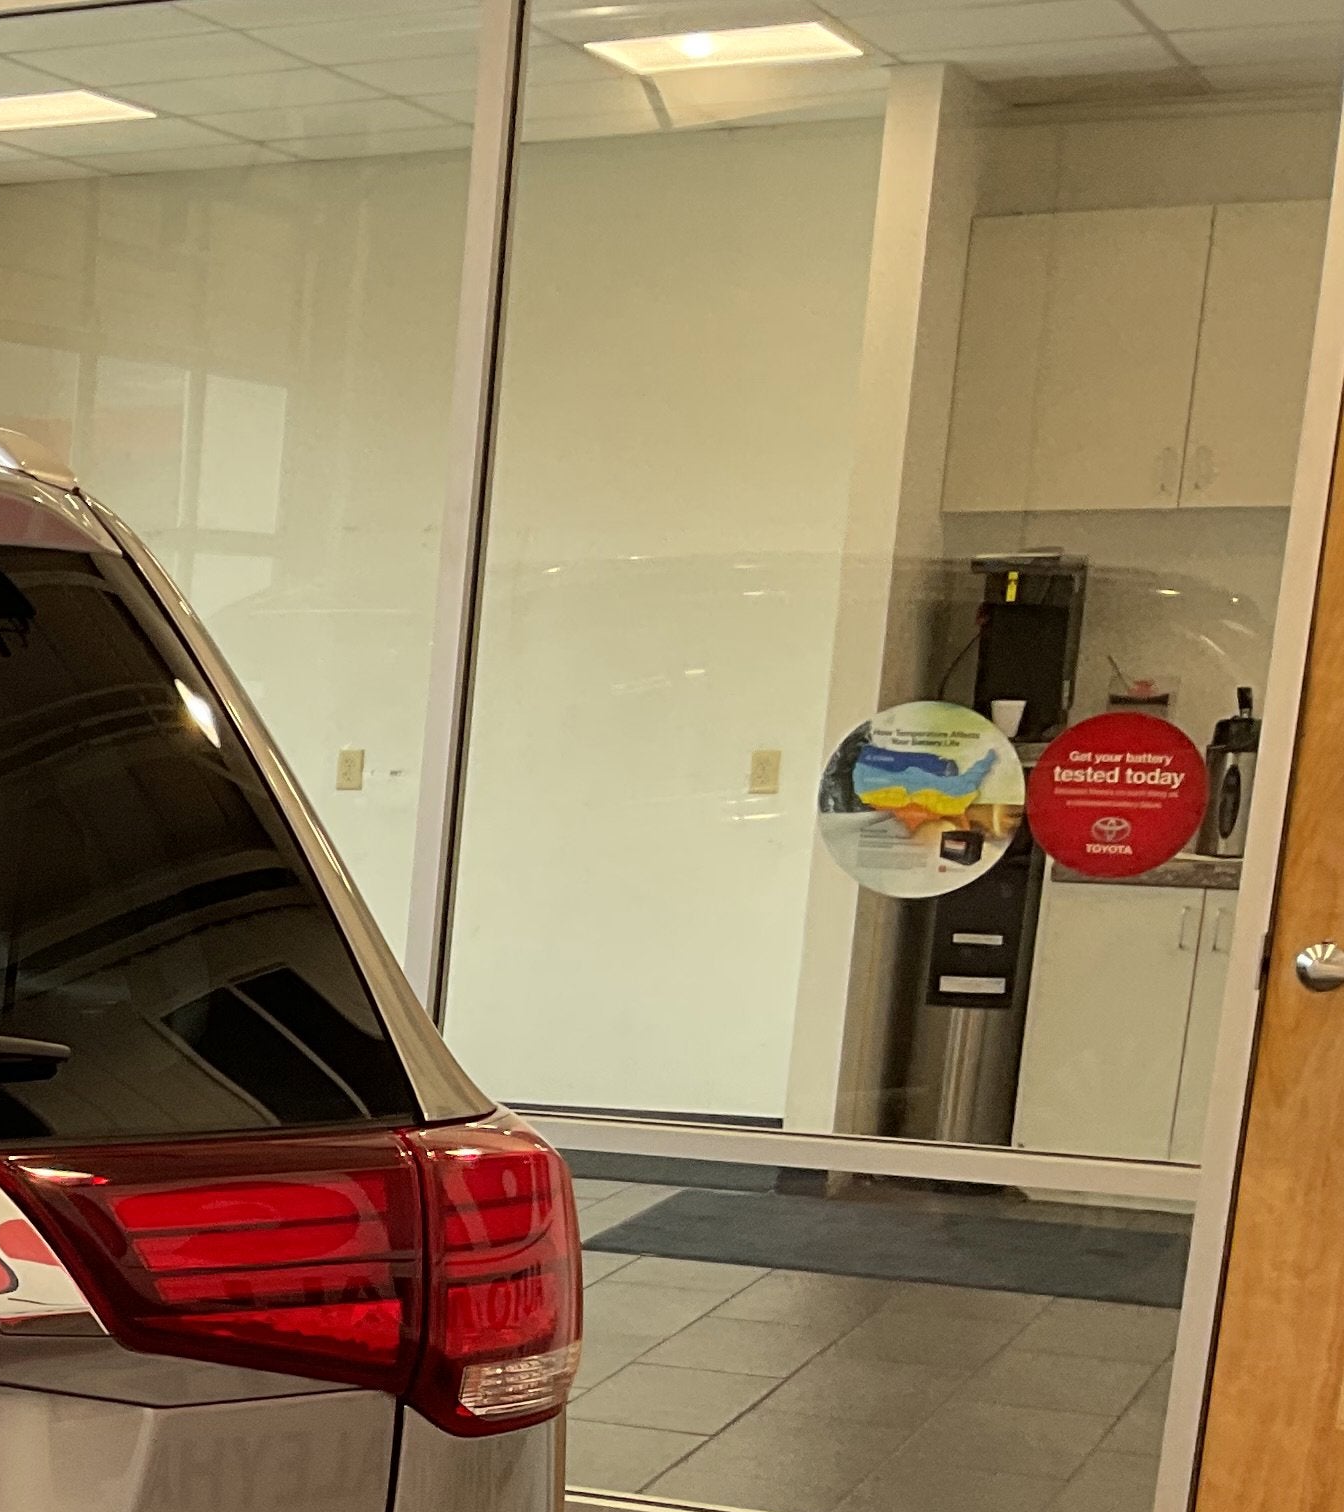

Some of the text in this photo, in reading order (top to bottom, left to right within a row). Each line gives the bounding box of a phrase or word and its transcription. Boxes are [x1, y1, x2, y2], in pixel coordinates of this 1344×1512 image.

[1069, 750, 1174, 767] Get your battery
[1053, 765, 1185, 789] tested today
[1086, 843, 1133, 855] TOYOTA
